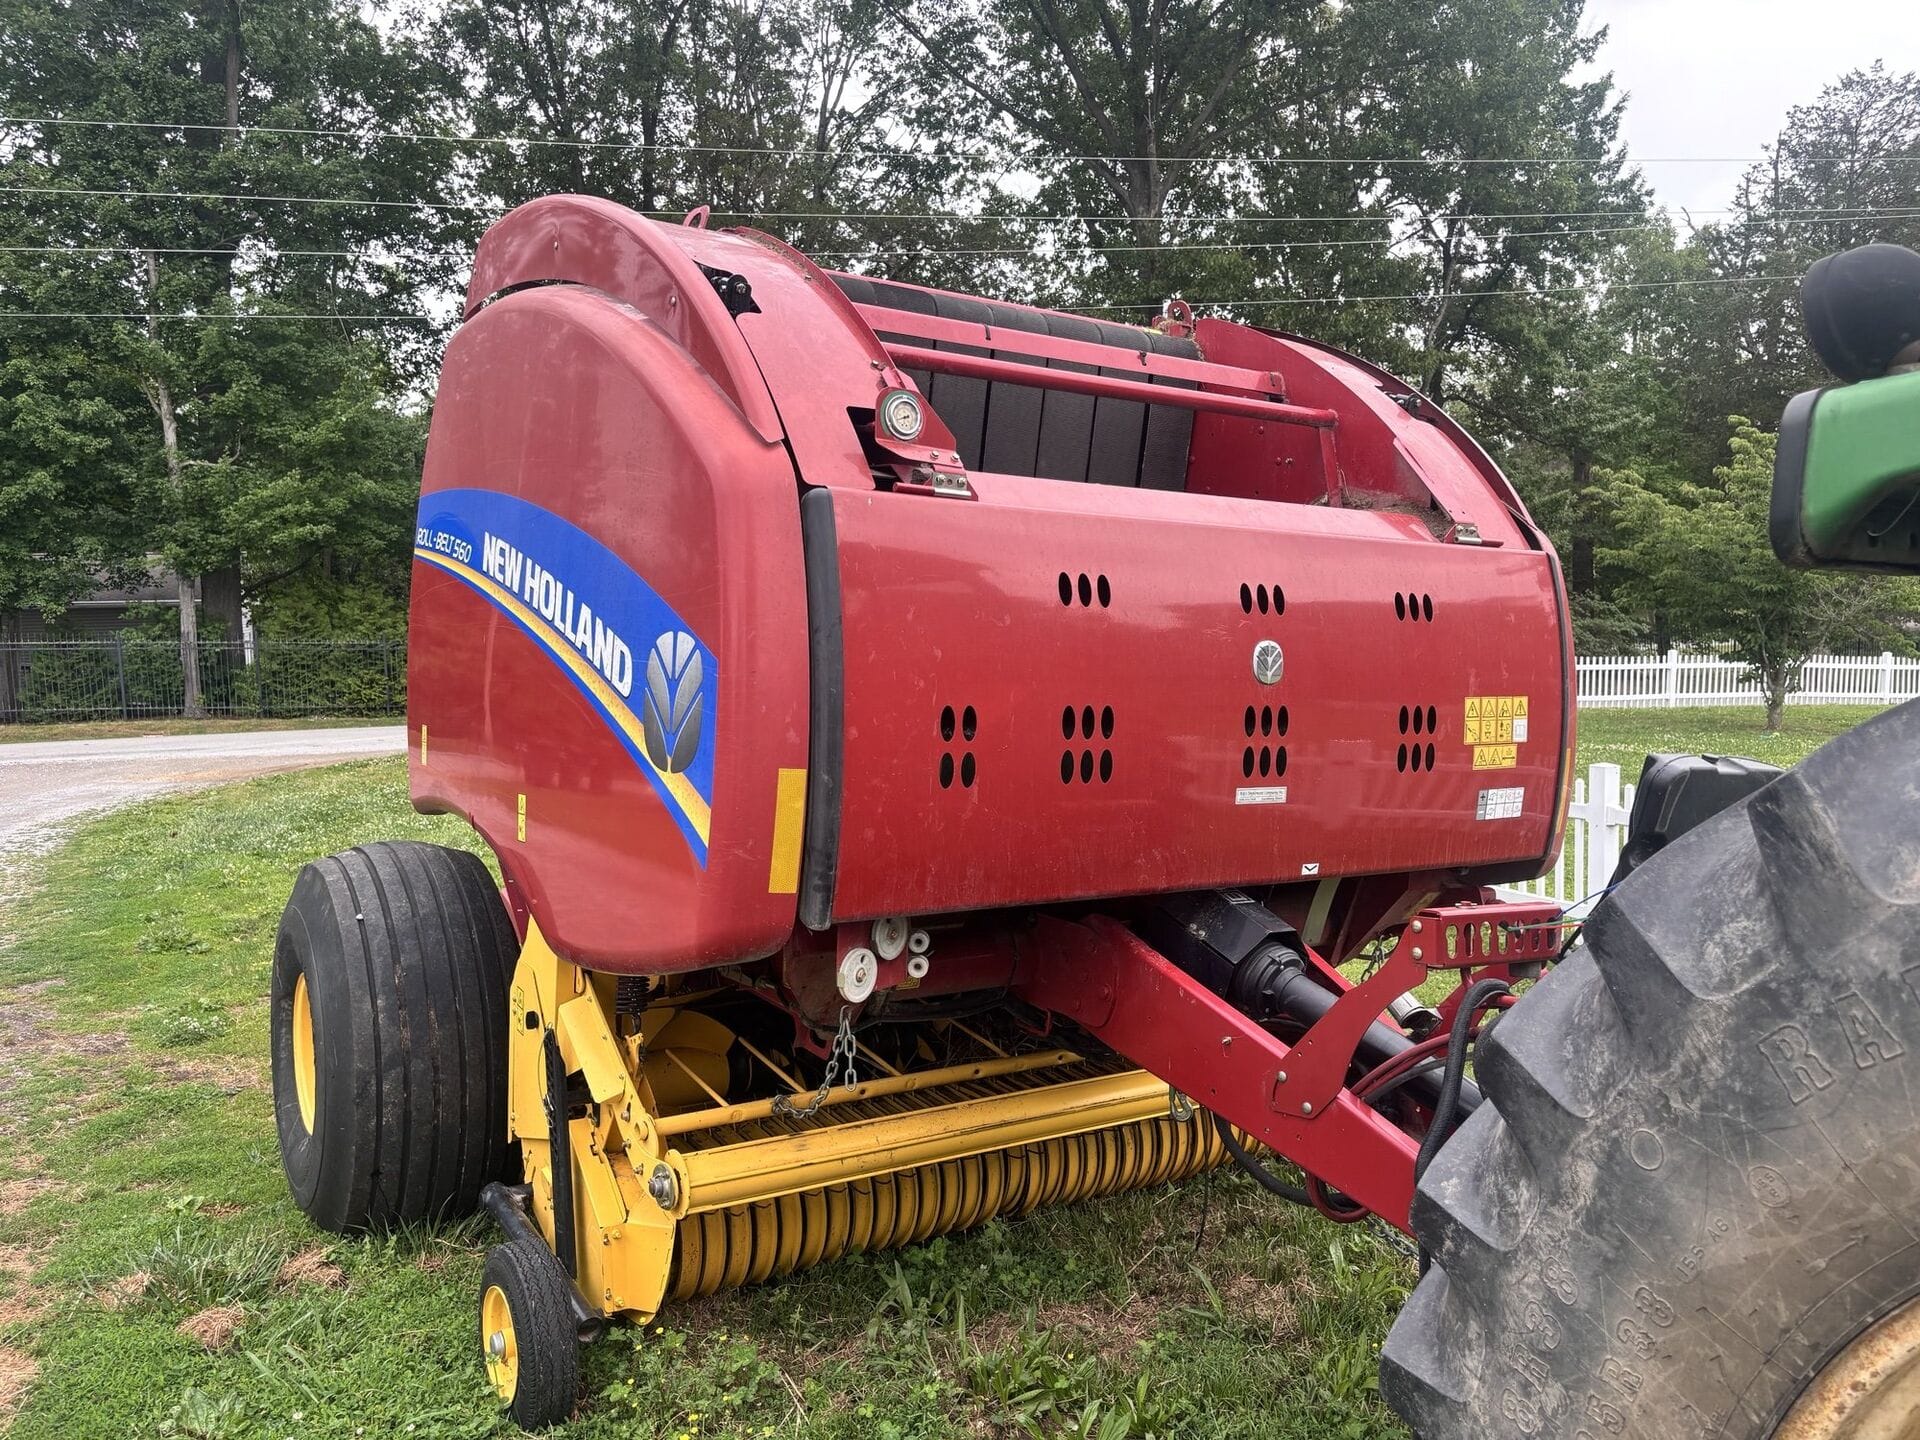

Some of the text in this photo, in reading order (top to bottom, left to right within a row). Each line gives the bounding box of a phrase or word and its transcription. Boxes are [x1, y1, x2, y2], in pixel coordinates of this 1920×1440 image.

[452, 538, 472, 563] 560
[482, 531, 633, 698] NEW HOLLAND
